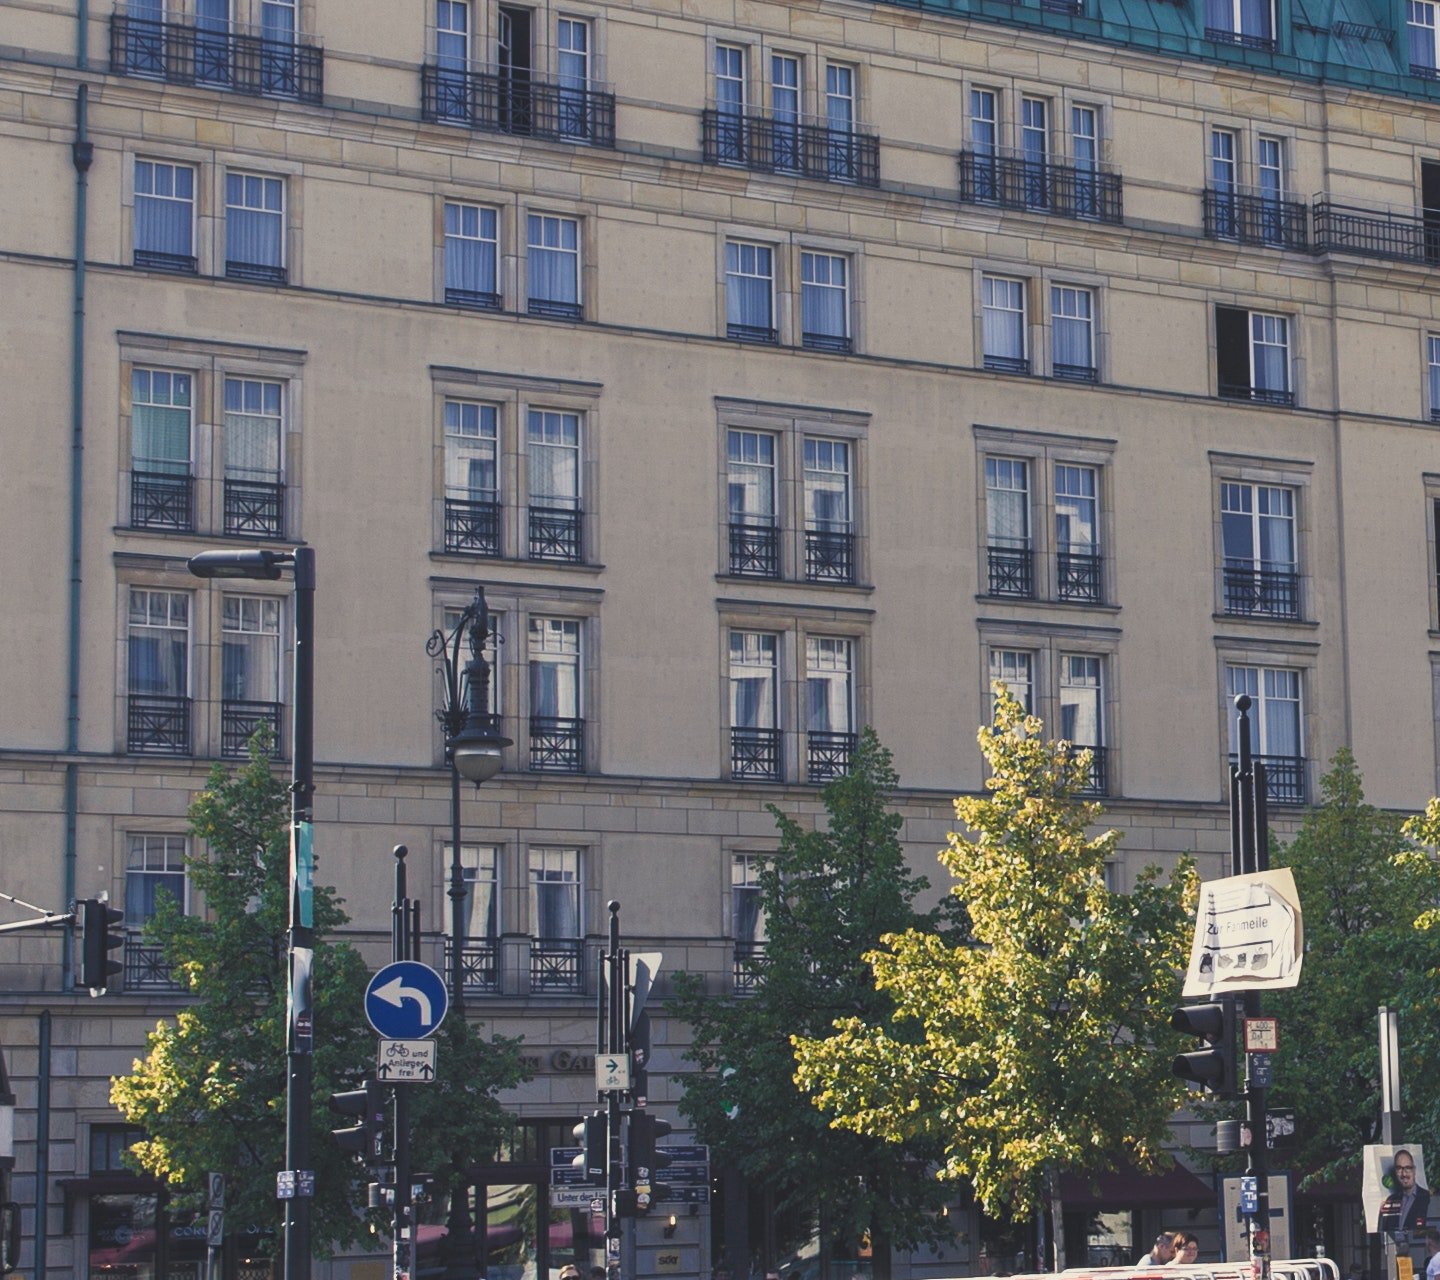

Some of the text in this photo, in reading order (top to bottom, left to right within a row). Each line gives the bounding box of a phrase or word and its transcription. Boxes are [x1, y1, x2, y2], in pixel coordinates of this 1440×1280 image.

[412, 1049, 429, 1058] und
[388, 1059, 425, 1068] Anlieger
[398, 1068, 415, 1077] frei
[558, 1191, 579, 1202] Unter
[580, 1192, 594, 1202] den
